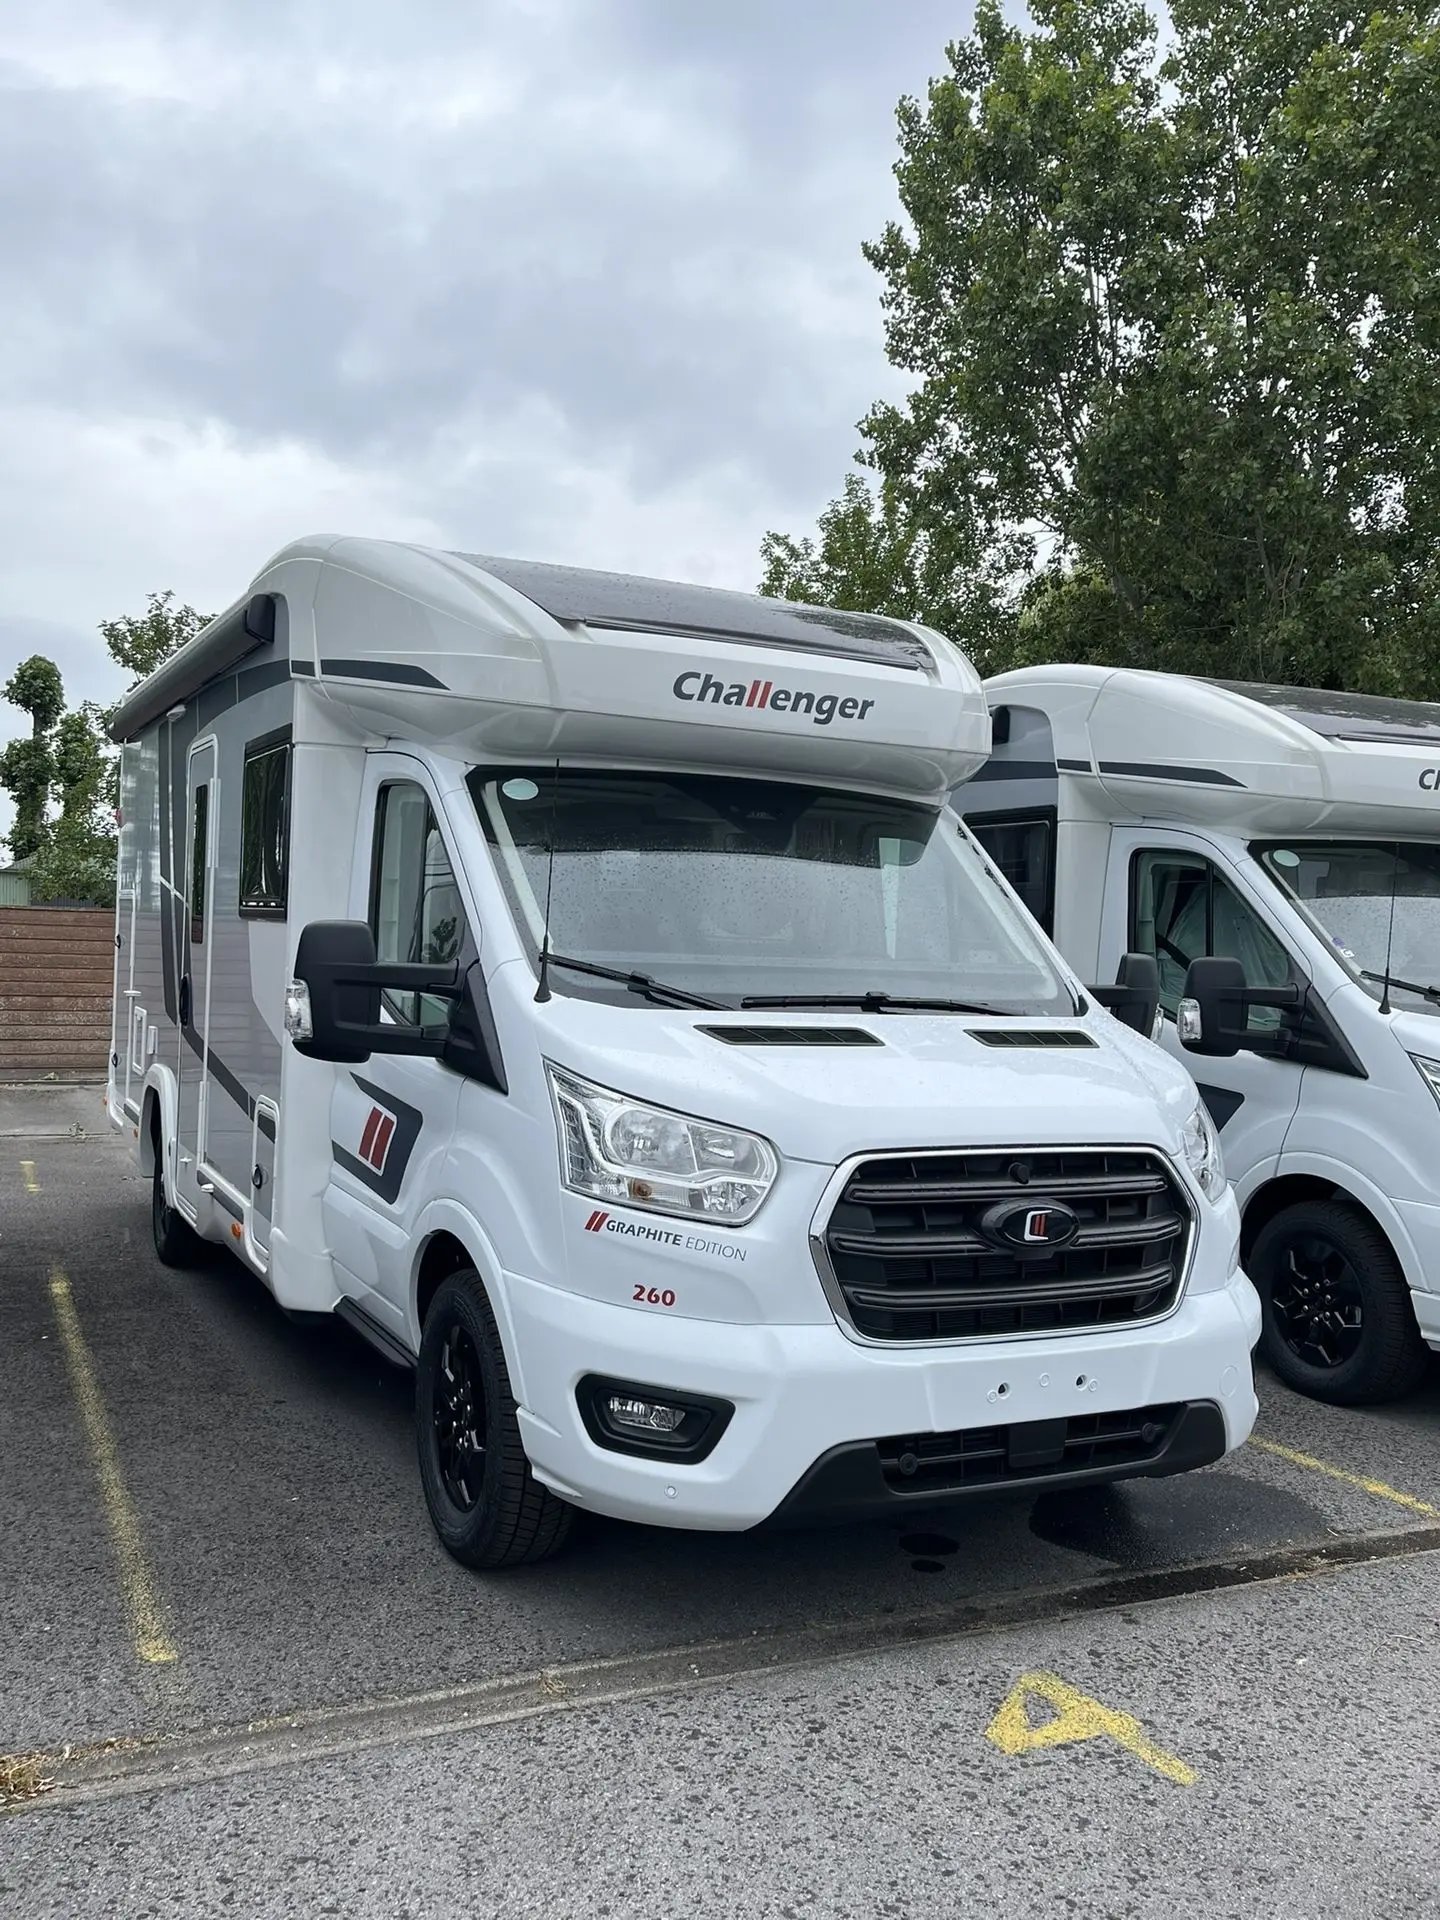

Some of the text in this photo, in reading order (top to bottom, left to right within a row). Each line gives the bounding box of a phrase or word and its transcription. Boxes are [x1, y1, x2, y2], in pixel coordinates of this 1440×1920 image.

[672, 670, 876, 726] Challenger
[606, 1218, 748, 1262] GRAPHITE EDITION
[632, 1284, 676, 1307] 260
